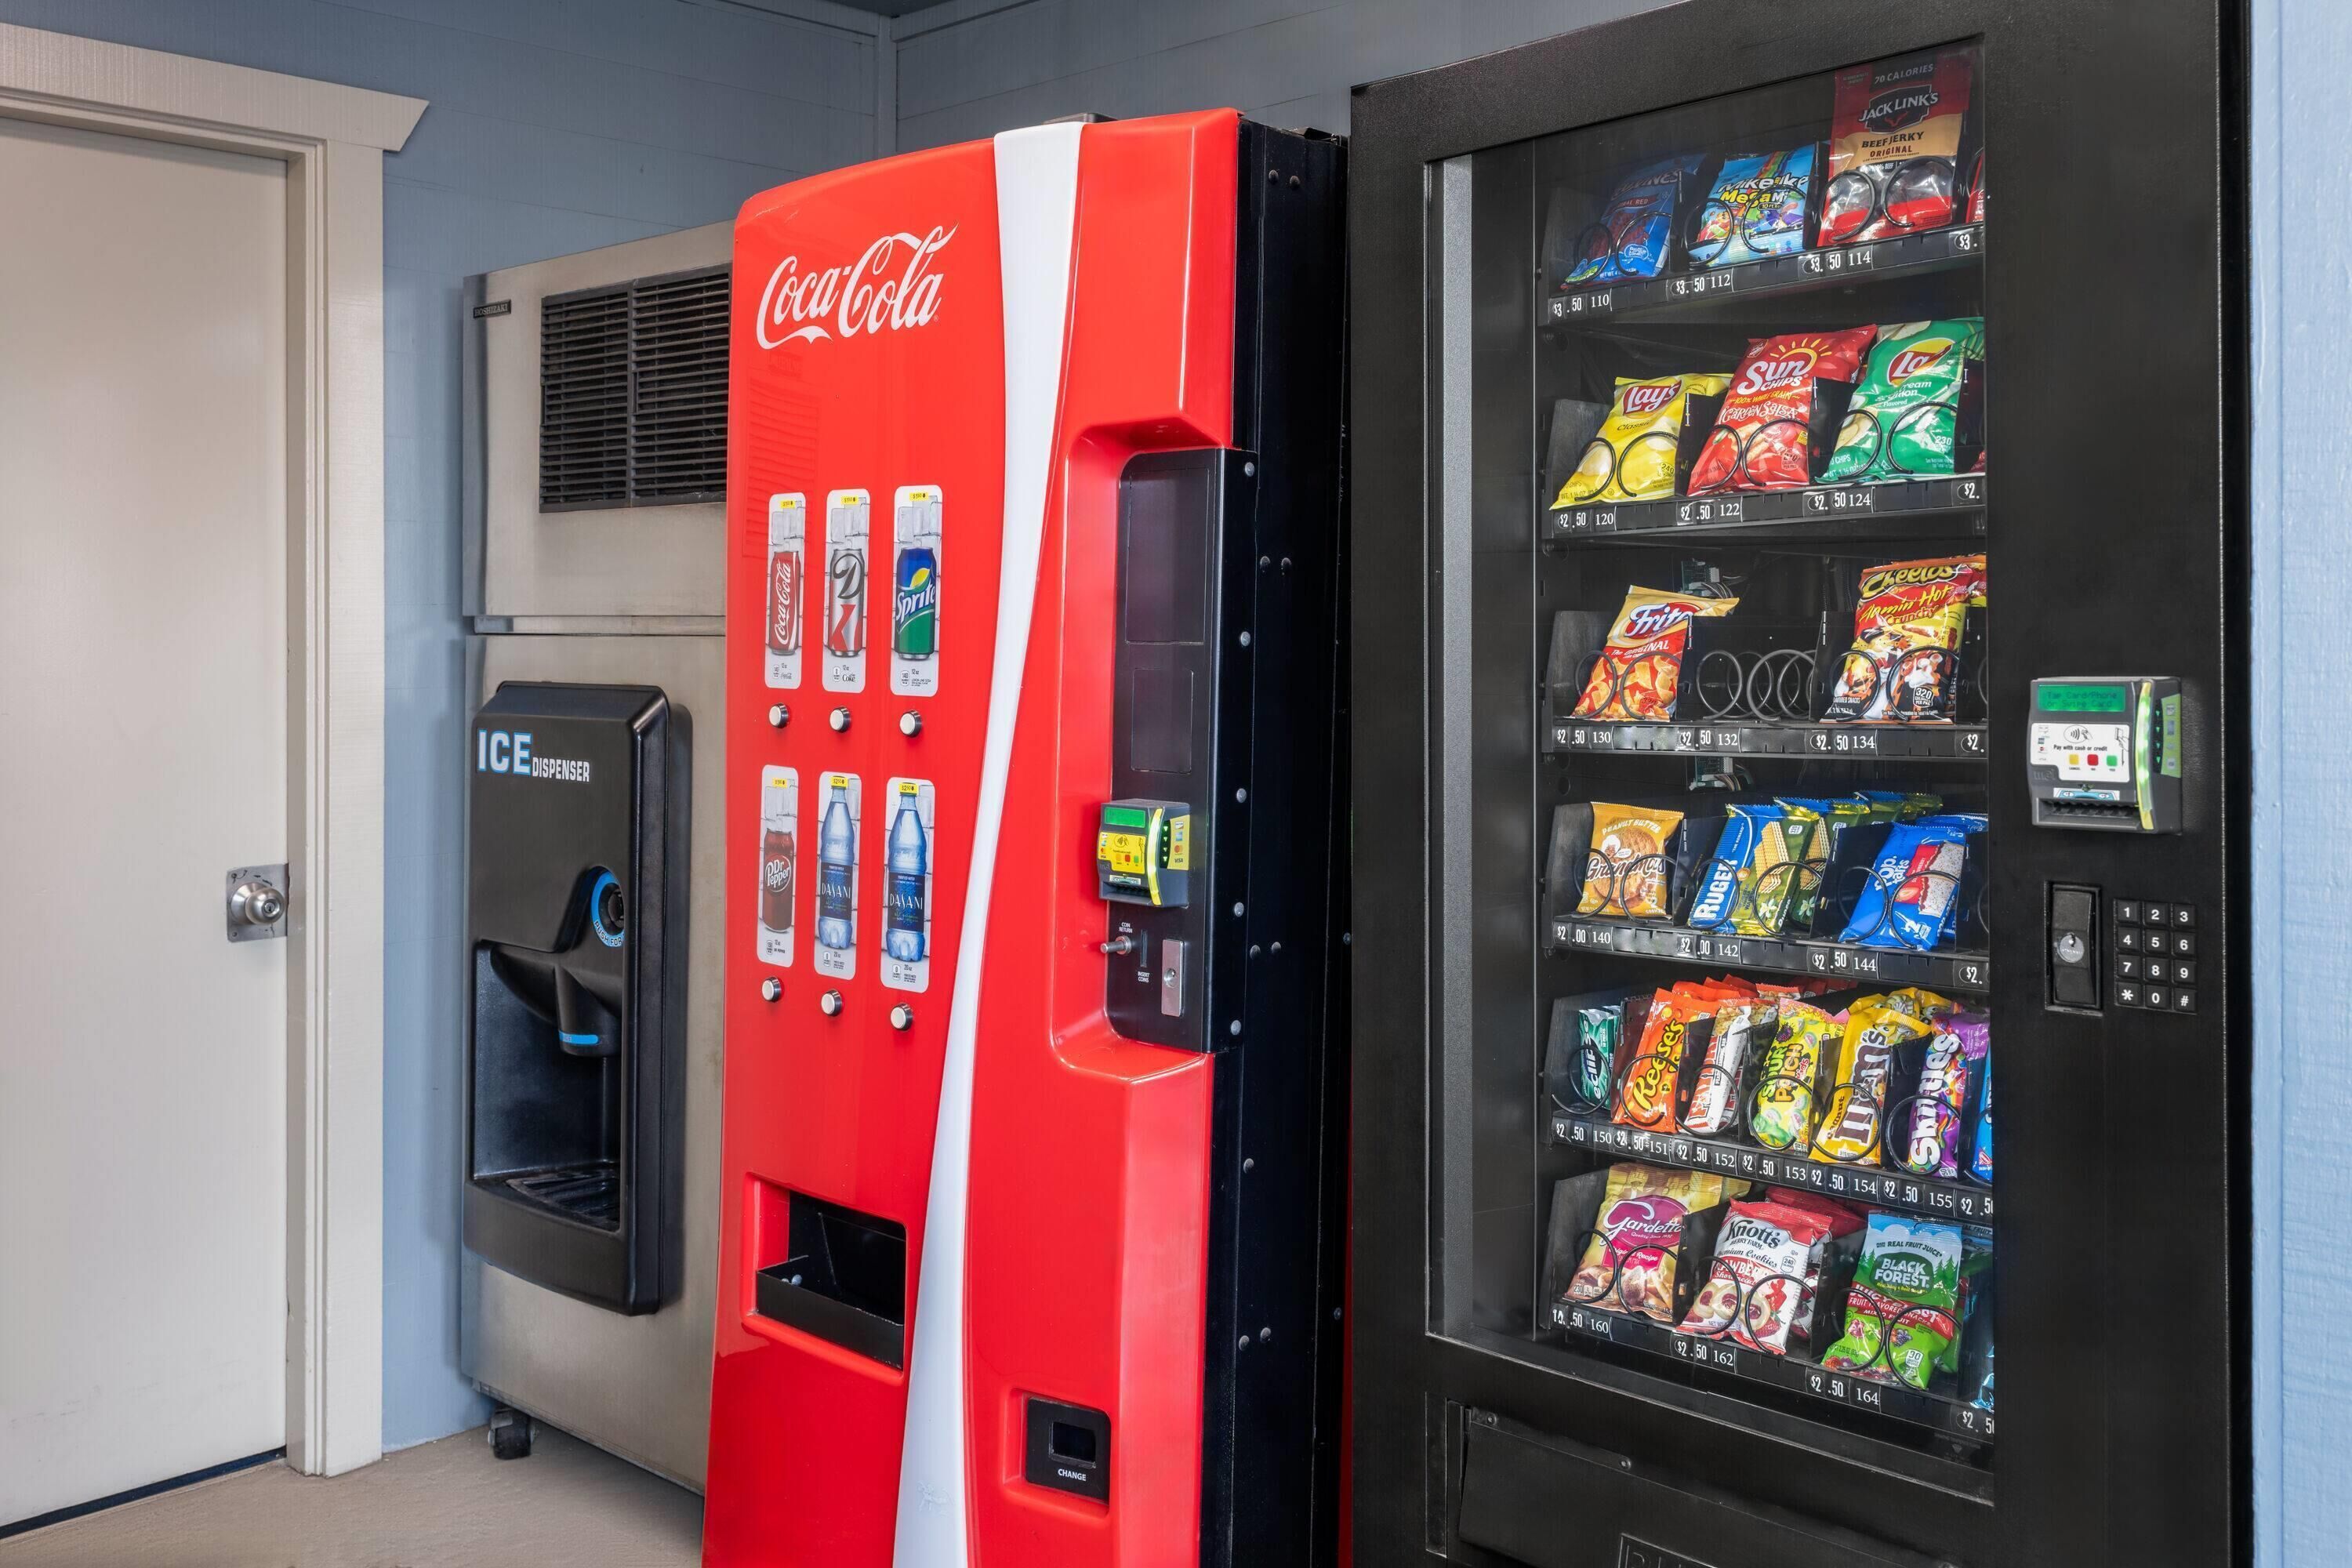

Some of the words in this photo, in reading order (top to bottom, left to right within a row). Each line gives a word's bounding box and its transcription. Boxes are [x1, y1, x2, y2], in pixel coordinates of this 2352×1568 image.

[1886, 63, 1934, 81] CALORIES
[1858, 100, 1900, 122] JACK
[1894, 93, 1938, 111] LINK'S
[1861, 136, 1888, 148] BEEF
[1888, 131, 1925, 144] JERKY
[1870, 145, 1912, 157] ORIGINAL
[1718, 176, 1774, 193] Mike
[1720, 189, 1771, 209] Mega
[1849, 250, 1871, 266] 114
[756, 222, 959, 350] Coca-Cola
[1711, 274, 1730, 289] 112
[1591, 294, 1610, 308] 110
[1760, 376, 1803, 391] CHIPS
[1625, 383, 1680, 412] Lay's
[1883, 398, 1907, 407] Flavored
[1617, 420, 1652, 431] Classic
[1936, 435, 1951, 445] 230
[1849, 493, 1871, 507] 124
[1720, 503, 1740, 516] 122
[1595, 513, 1613, 525] 120
[1862, 565, 1954, 599] Cheetos
[773, 558, 793, 644] Coca-Cola
[895, 583, 936, 621] Sprite
[1919, 585, 1953, 607] Hot
[1624, 602, 1693, 637] Frito
[1885, 605, 1940, 625] Crunchy
[1915, 688, 1933, 699] 320
[1592, 731, 1611, 743] 130
[1718, 734, 1737, 746] 132
[1853, 735, 1875, 749] 134
[478, 728, 532, 775] ICE
[532, 757, 590, 782] DISPENSER
[1602, 818, 1633, 844] PEANUT
[1633, 819, 1661, 834] BUTTER
[774, 859, 785, 873] Dr
[766, 862, 790, 887] Pepper
[821, 883, 851, 899] DASANI
[1693, 859, 1738, 920] RUGER
[889, 893, 923, 910] DASANI
[2124, 907, 2130, 917] 1
[2151, 909, 2160, 920] 2
[2180, 911, 2188, 922] 3
[1592, 931, 1610, 944] 140
[2123, 935, 2132, 946] 4
[2151, 937, 2160, 948] 5
[2180, 939, 2188, 950] 6
[1719, 943, 1738, 957] 142
[1853, 956, 1876, 971] 144
[2123, 962, 2132, 973] 7
[2151, 965, 2160, 976] 8
[2180, 967, 2189, 979] 9
[2151, 993, 2160, 1004] 0
[1633, 1018, 1687, 1112] Reese's
[1762, 1044, 1787, 1101] SOUR
[1774, 1043, 1804, 1102] PATCH
[1910, 1033, 1959, 1167] Skittles
[1594, 1130, 1612, 1143] 150
[1650, 1140, 1668, 1155] 151
[1715, 1152, 1736, 1167] 152
[1785, 1166, 1806, 1181] 153
[1854, 1178, 1877, 1194] 154
[1929, 1192, 1953, 1209] 155
[1723, 1220, 1780, 1249] Knott's
[1748, 1240, 1763, 1250] FARM
[1636, 1252, 1658, 1261] Recipe
[1747, 1250, 1777, 1268] Cookies
[1882, 1258, 1926, 1275] BLACK
[1875, 1269, 1930, 1288] FOREST
[1849, 1298, 1867, 1307] FRUIT
[1591, 1319, 1609, 1334] 160
[1714, 1350, 1733, 1367] 162
[1857, 1388, 1880, 1405] 164
[1058, 1468, 1087, 1482] CHANGE
